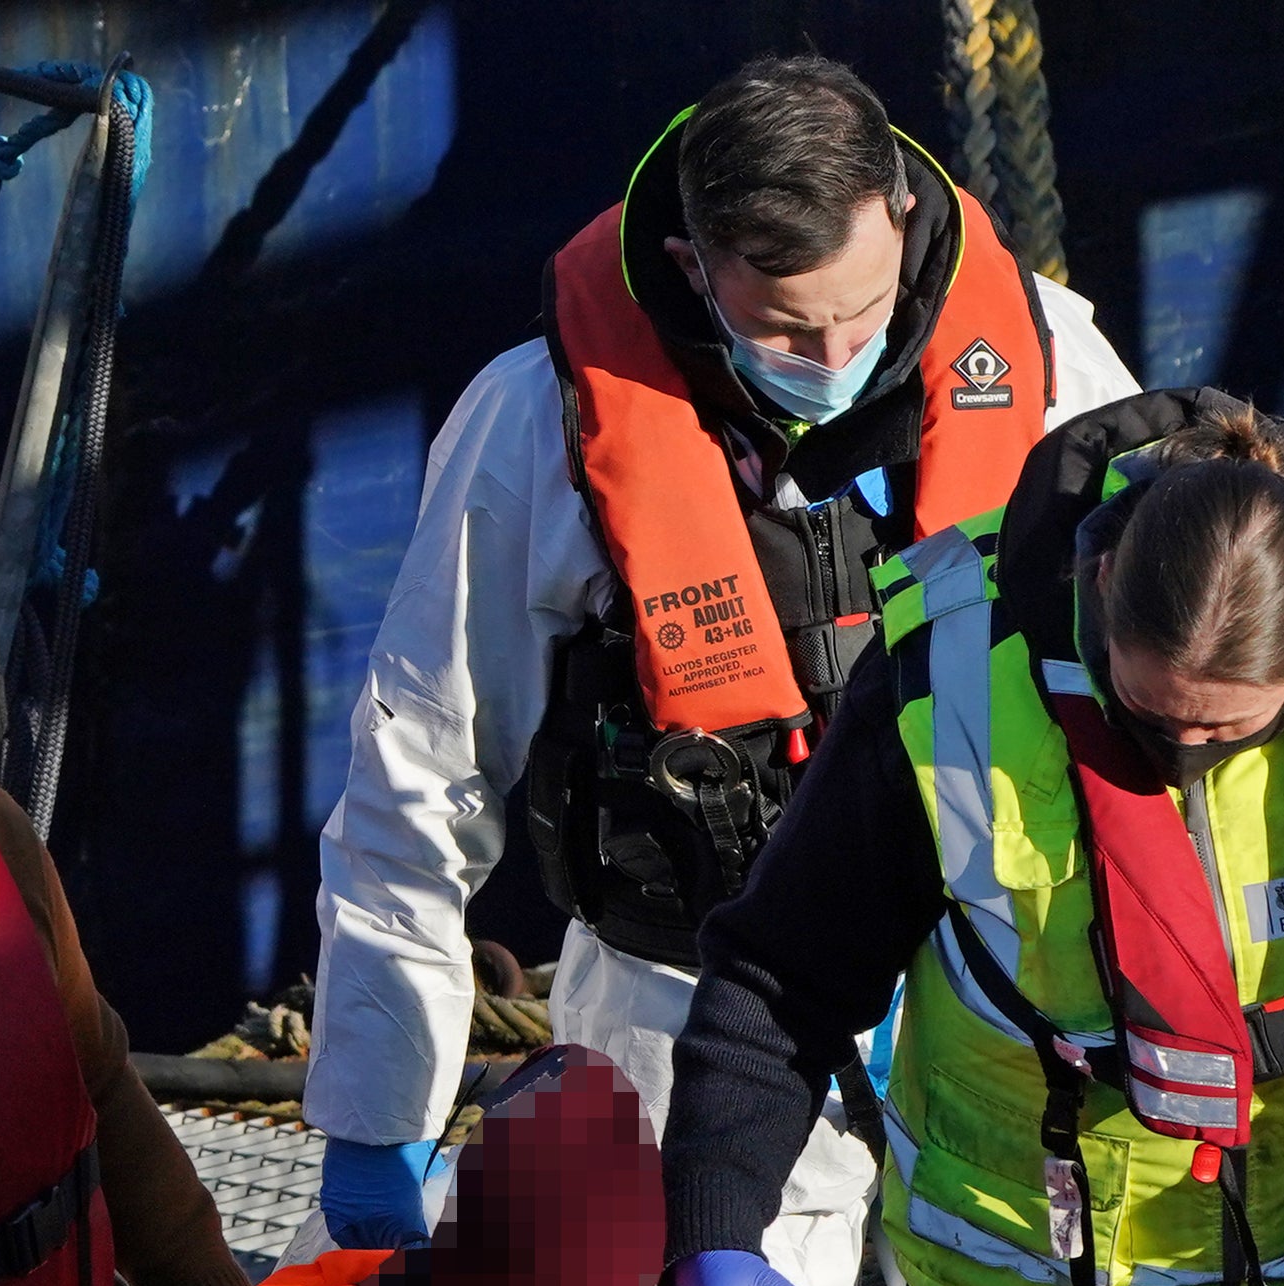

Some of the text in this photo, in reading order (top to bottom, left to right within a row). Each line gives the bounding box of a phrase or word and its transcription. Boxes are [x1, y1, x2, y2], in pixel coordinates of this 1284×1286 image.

[956, 393, 1010, 404] Crewsaver
[643, 574, 738, 617] FRONT
[693, 596, 745, 628] ADULT
[704, 618, 753, 644] 43+KG
[662, 643, 758, 676] LLOYDS REGISTER
[668, 666, 765, 697] AUTHORISED BY MCA
